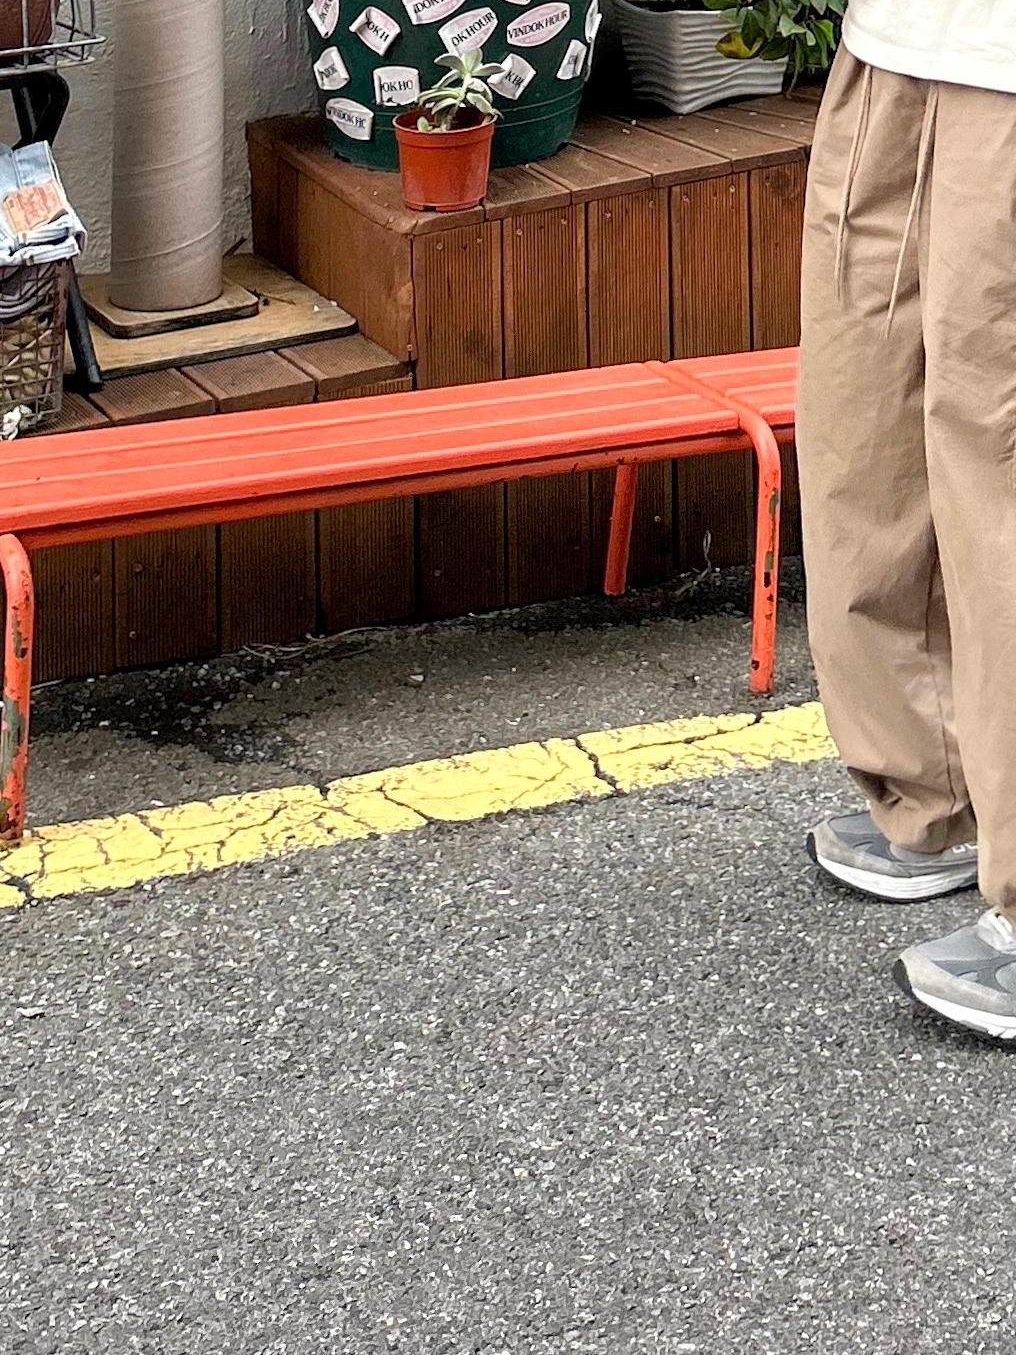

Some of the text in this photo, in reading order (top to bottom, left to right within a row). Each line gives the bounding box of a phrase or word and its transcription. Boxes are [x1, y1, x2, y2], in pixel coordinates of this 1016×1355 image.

[367, 19, 382, 35] OK
[452, 12, 495, 46] OK HOUR
[507, 10, 568, 39] VINDOK HOUR
